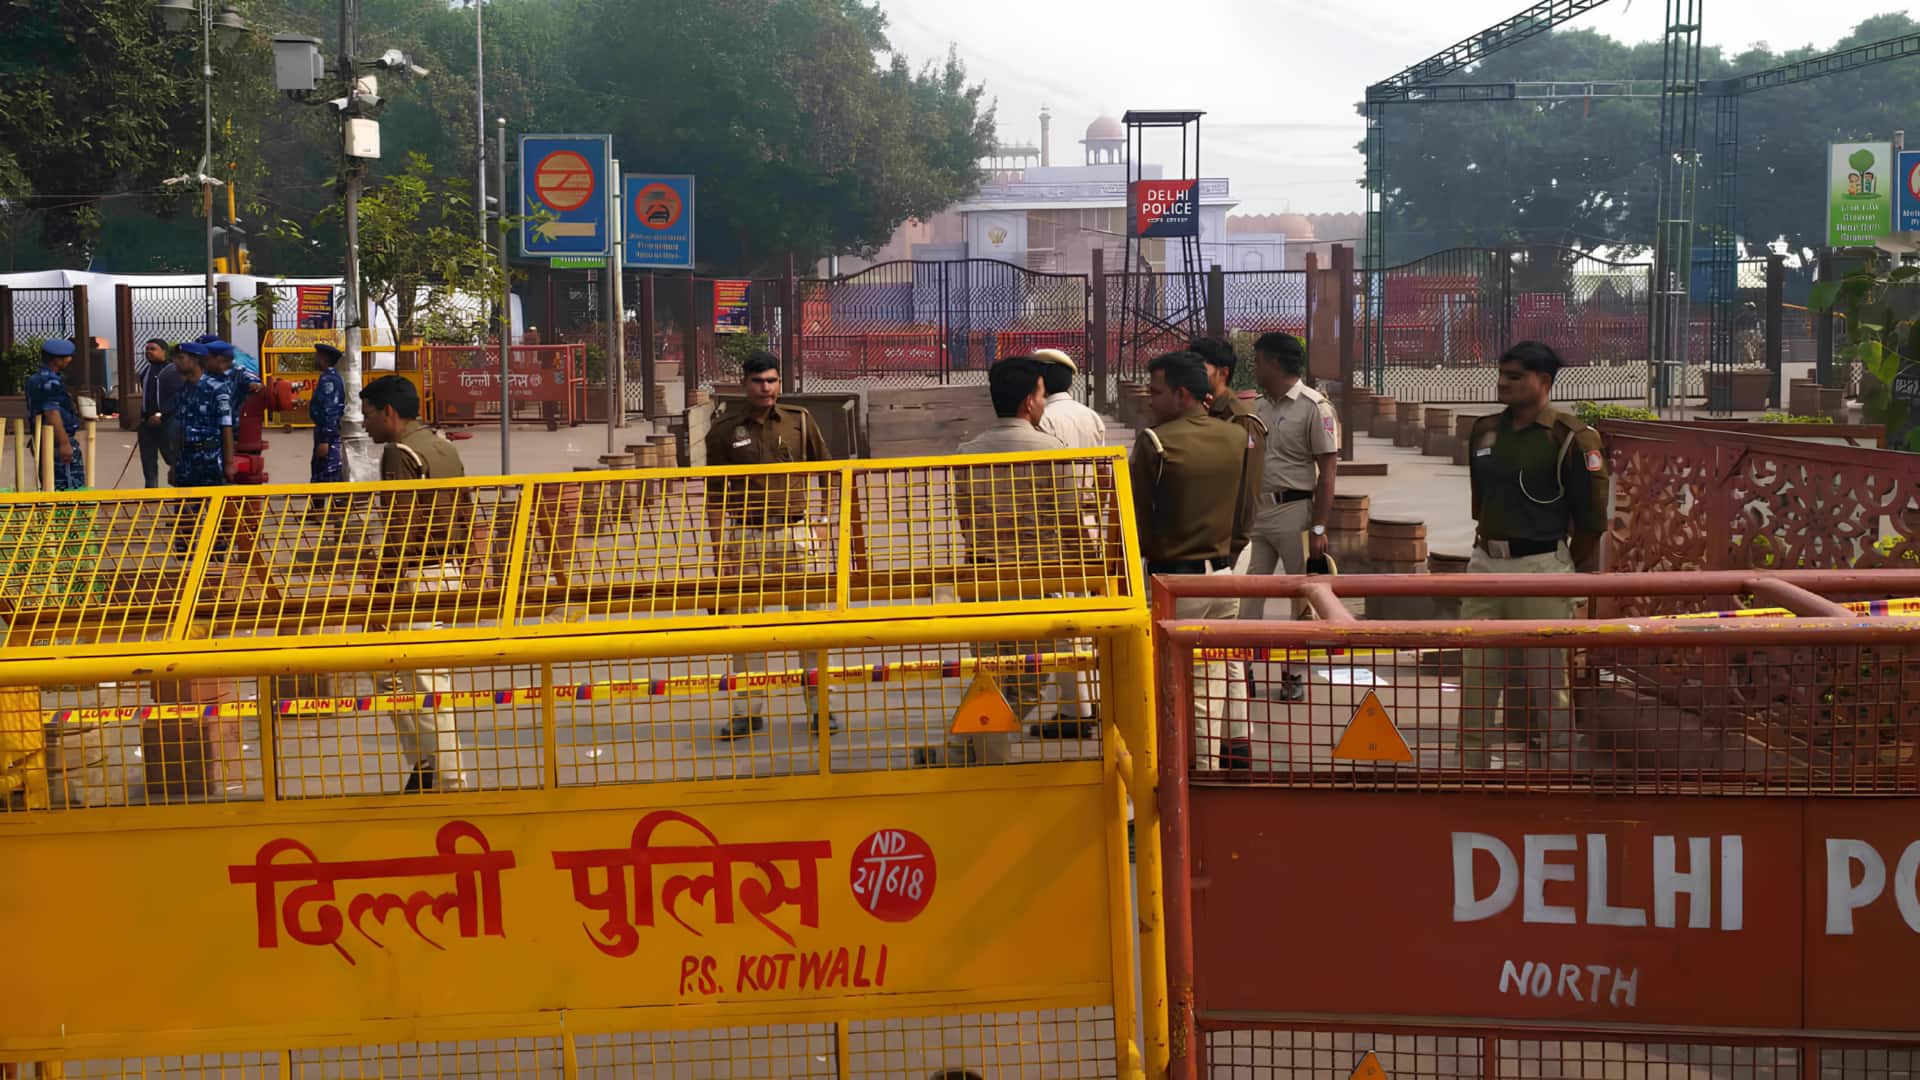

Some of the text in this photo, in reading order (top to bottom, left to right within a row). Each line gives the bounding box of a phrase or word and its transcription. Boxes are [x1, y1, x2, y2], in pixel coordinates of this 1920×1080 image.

[1142, 202, 1192, 215] POLICE
[1147, 189, 1189, 201] DELHI
[870, 831, 907, 856] ND
[228, 810, 832, 966] दिल्ली पुलिस
[1451, 831, 1743, 931] DELHI
[736, 944, 888, 994] KOTWALI
[1499, 960, 1639, 1008] NORTH
